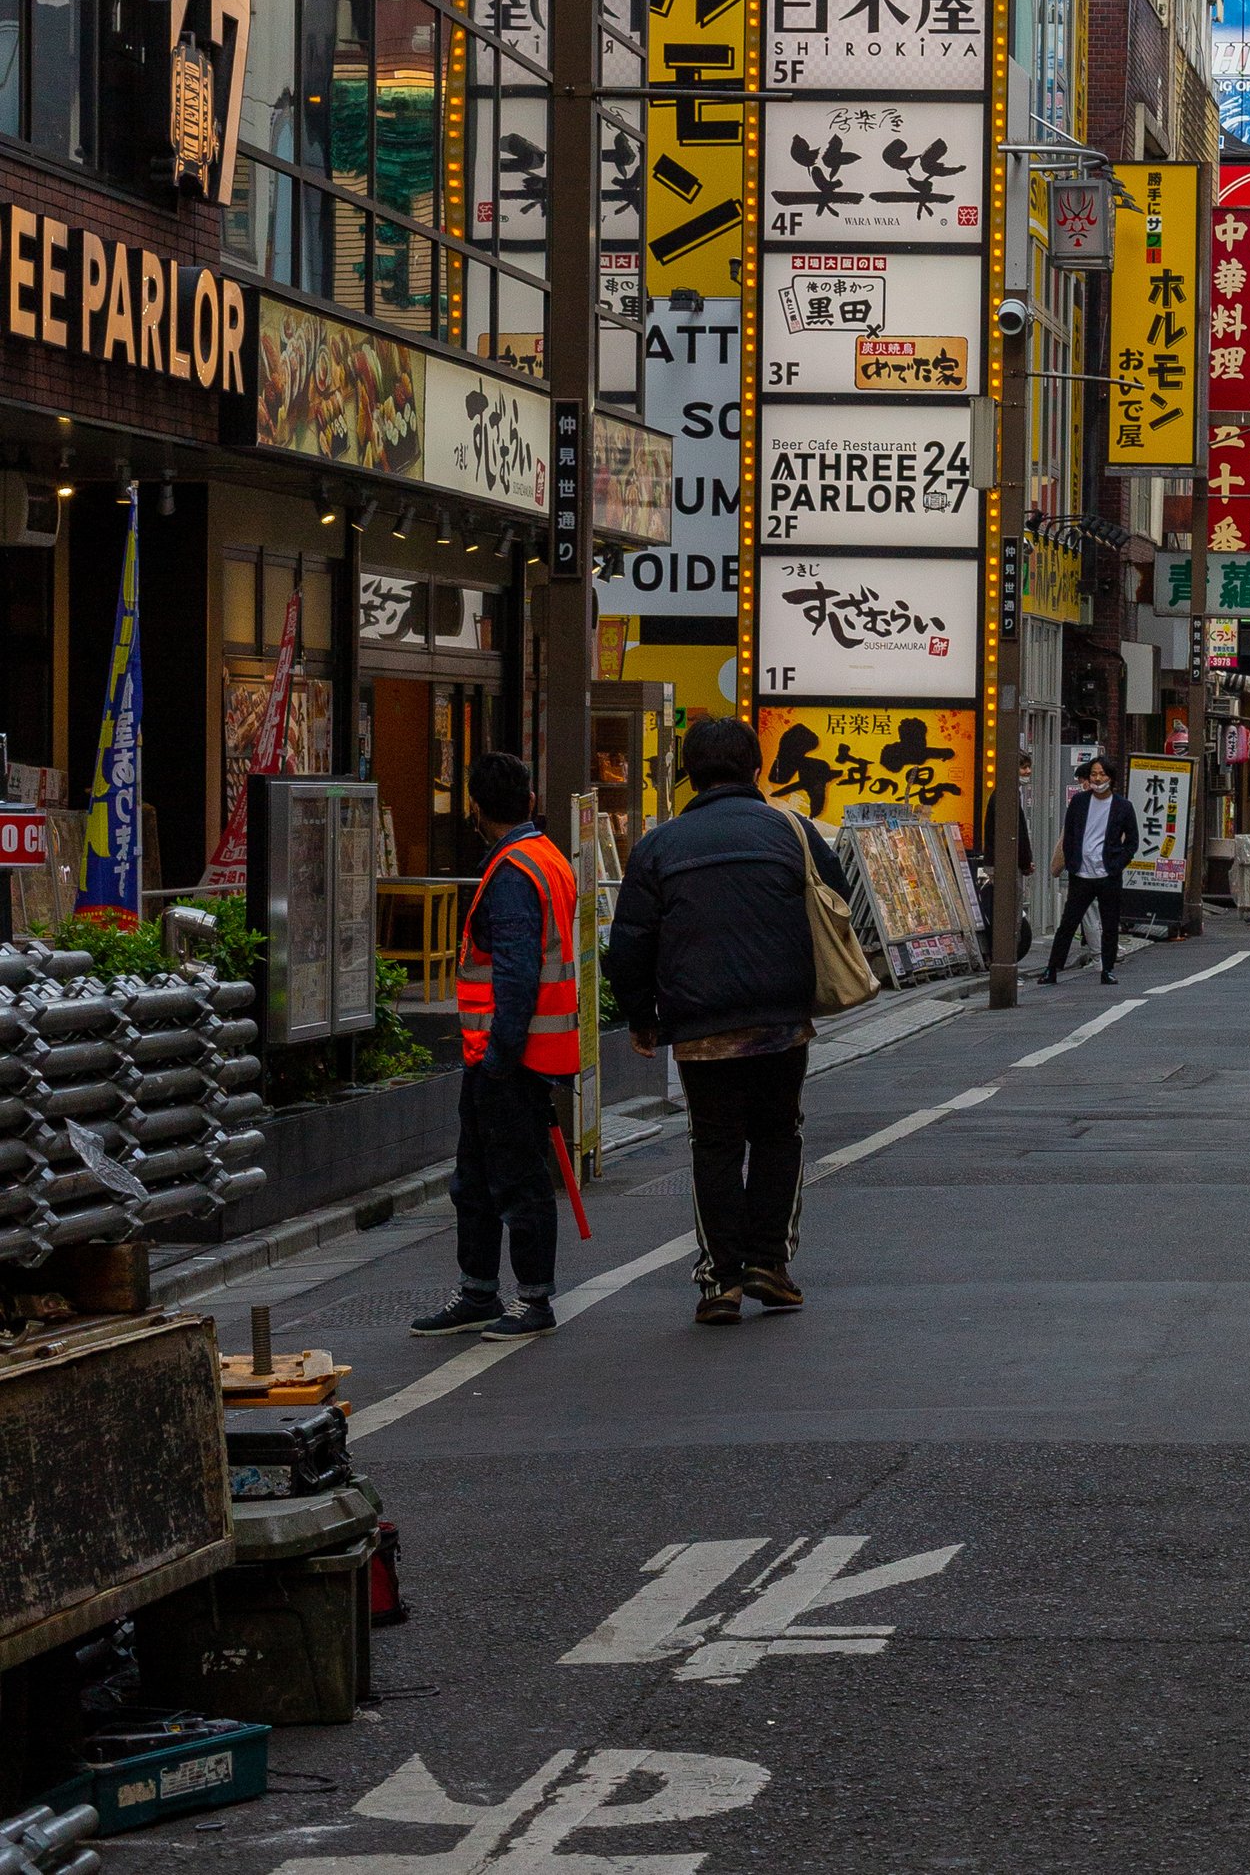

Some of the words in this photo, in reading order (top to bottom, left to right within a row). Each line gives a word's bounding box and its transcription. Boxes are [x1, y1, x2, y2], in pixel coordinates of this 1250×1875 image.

[773, 60, 805, 84] 5F
[771, 133, 967, 221] 笑笑
[771, 212, 803, 237] 4F
[844, 217, 872, 227] WARA
[873, 217, 901, 227] WARA
[1147, 172, 1162, 264] 勝手にサワー
[806, 279, 875, 297] 俺の串かつ
[1209, 213, 1249, 381] 中華料理
[82, 227, 246, 396] PARLOR
[805, 296, 873, 327] 黒田
[860, 342, 915, 356] 炭火焼鳥
[1147, 268, 1188, 432] ホルモン
[768, 361, 800, 386] 3F
[861, 348, 964, 387] めでた家
[1116, 348, 1145, 449] おいで屋
[771, 439, 806, 452] Beer
[808, 438, 839, 452] Cafe
[842, 439, 918, 452] Restaurant
[770, 453, 917, 482] ATHREE
[557, 413, 578, 564] 仲見世通り
[770, 484, 916, 513] PARLOR
[766, 515, 799, 539] 2F
[780, 563, 820, 578] つきじ
[1004, 545, 1017, 631] 仲見世通り
[863, 641, 927, 652] SUSHIZAMURAI
[1193, 620, 1201, 678] 仲見世通り
[765, 666, 796, 691] 1F
[825, 713, 892, 736] 居楽屋
[1143, 774, 1165, 857] ホルモン
